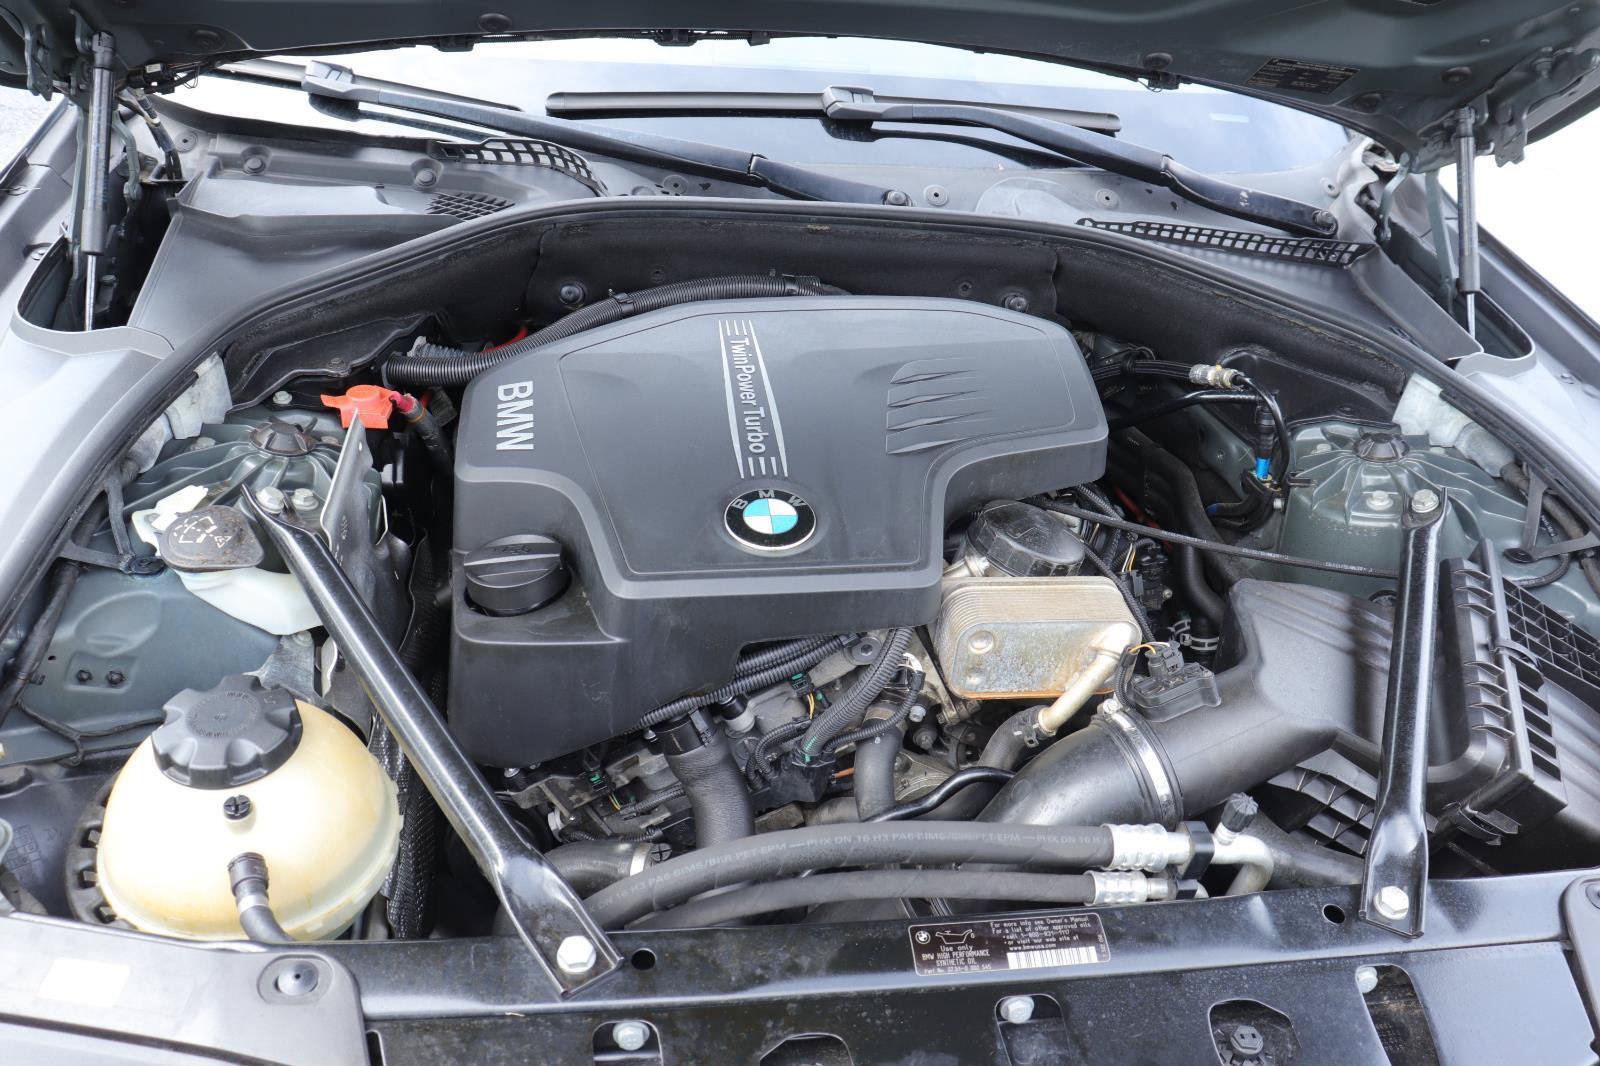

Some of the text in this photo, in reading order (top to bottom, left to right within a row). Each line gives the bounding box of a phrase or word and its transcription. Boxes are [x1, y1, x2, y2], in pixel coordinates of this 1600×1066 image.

[730, 338, 769, 454] TwinPower Turbo
[496, 381, 534, 450] BMW
[732, 489, 808, 510] BMW
[834, 836, 851, 844] DN
[857, 835, 870, 843] 16
[873, 833, 889, 842] H3
[952, 949, 990, 958] PERFORMANCE
[958, 944, 974, 952] only
[936, 958, 966, 966] SYNTHETIC
